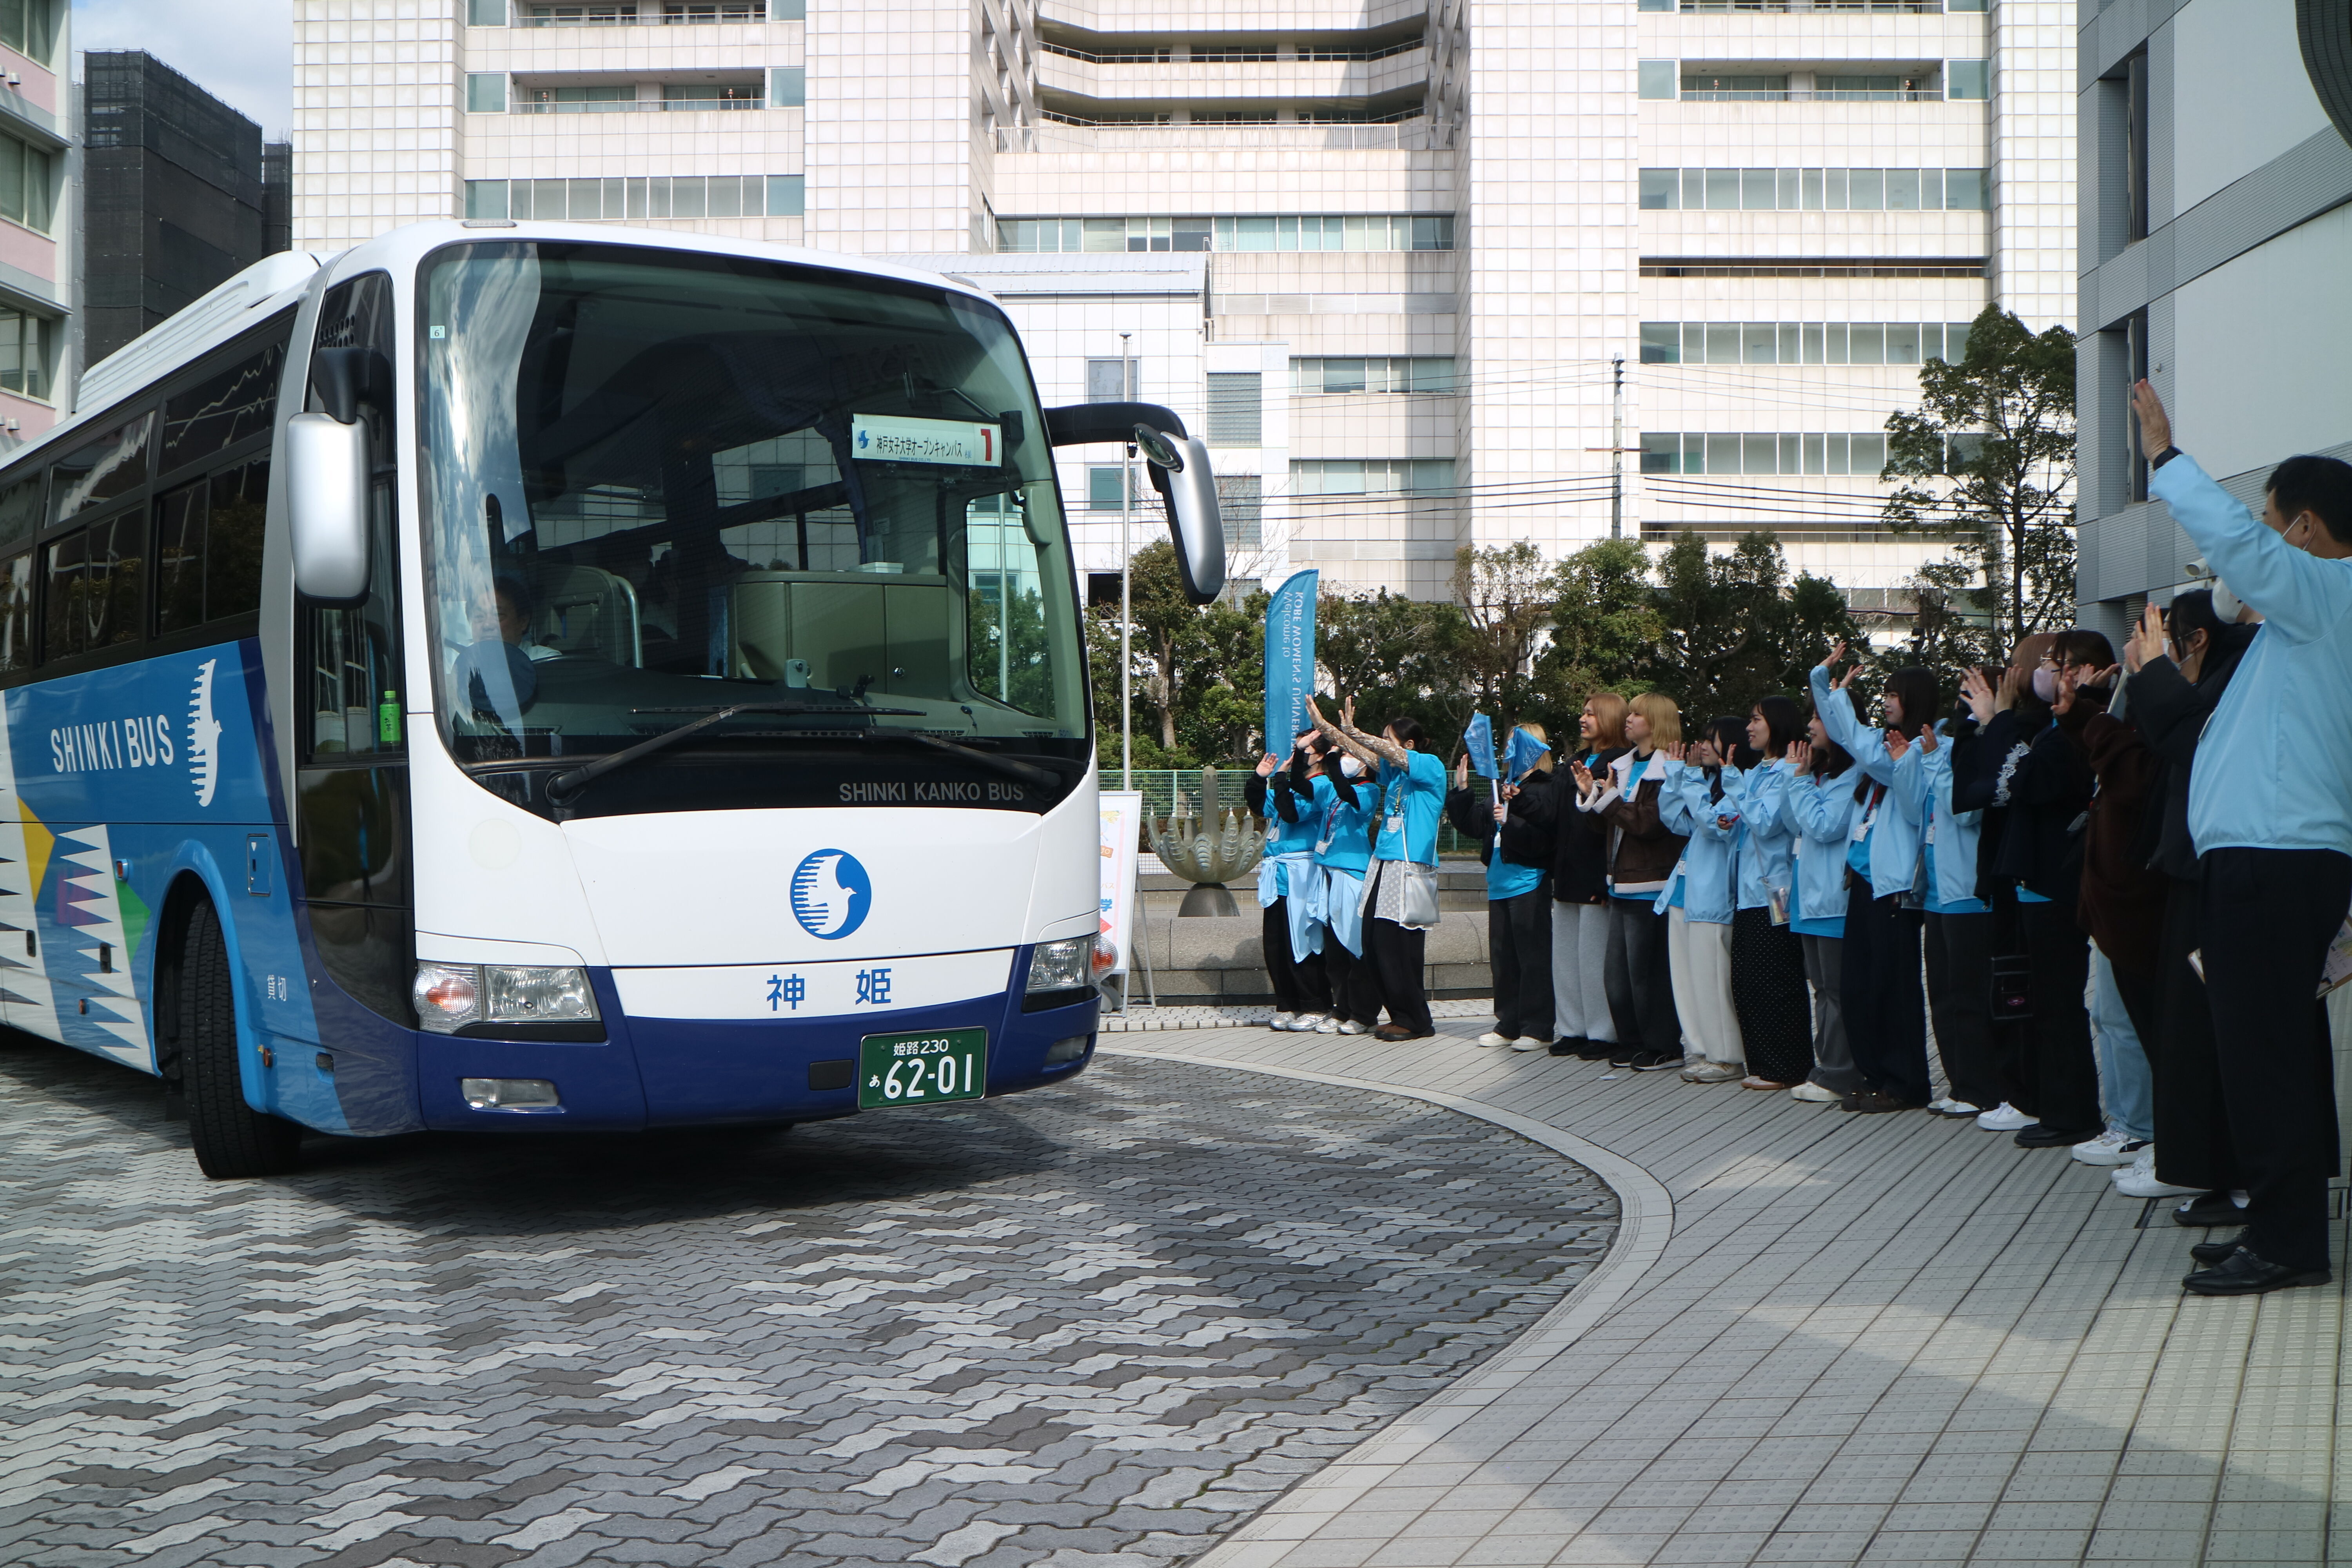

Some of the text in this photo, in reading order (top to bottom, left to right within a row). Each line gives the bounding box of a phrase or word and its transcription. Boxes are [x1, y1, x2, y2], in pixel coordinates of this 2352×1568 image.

[877, 434, 962, 457] 神戸女子大学オープンキャンパス
[981, 429, 992, 461] 1
[51, 714, 174, 773] SHINKI BUS
[839, 782, 1024, 801] SHINKI KANKO BUS
[267, 975, 286, 1002] 貸切
[869, 1054, 972, 1099] あ 62-01
